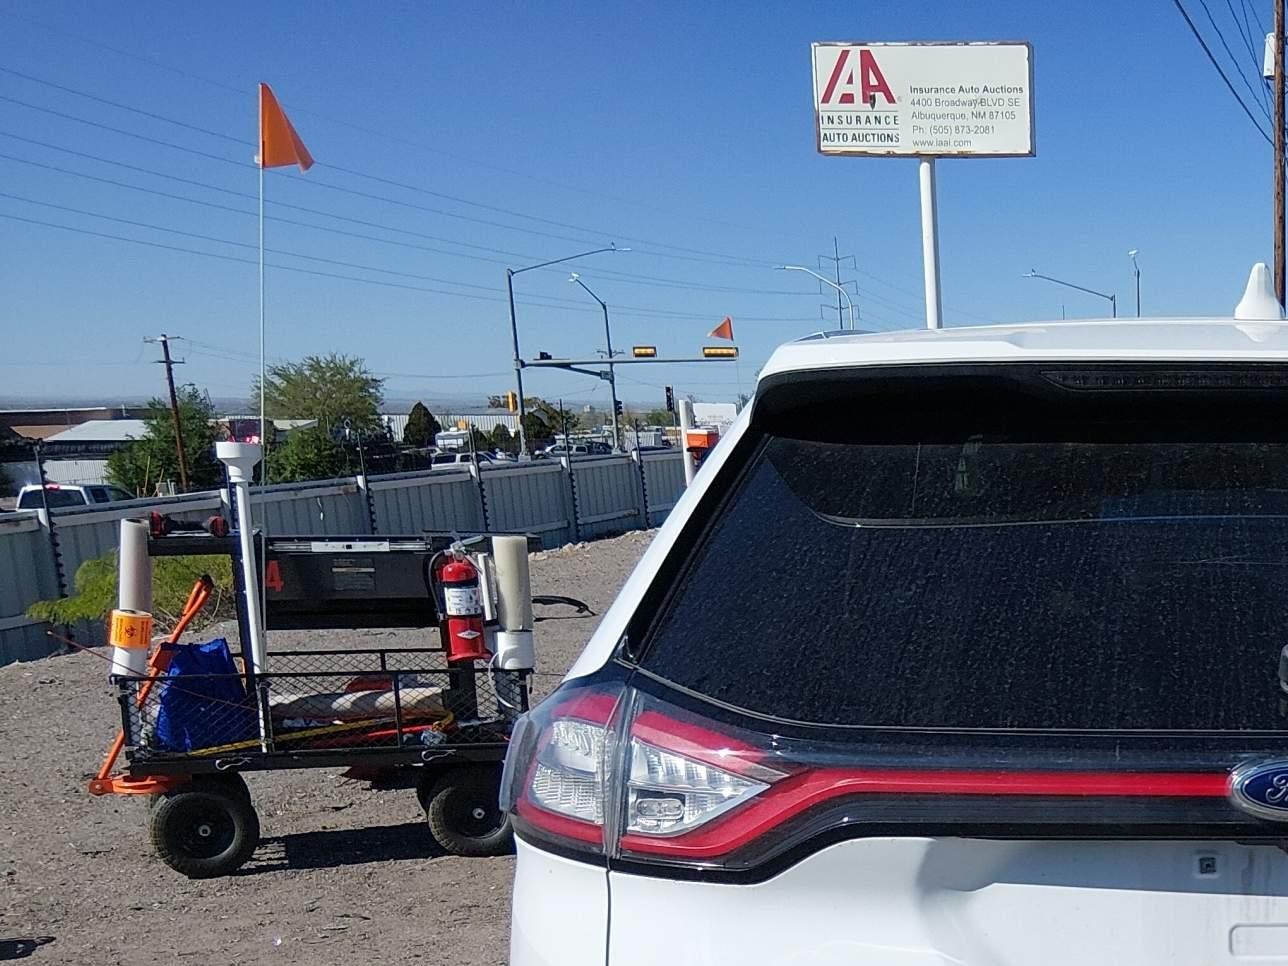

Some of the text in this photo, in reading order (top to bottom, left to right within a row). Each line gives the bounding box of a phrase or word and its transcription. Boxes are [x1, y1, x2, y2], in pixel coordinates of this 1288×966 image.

[910, 85, 1024, 94] Insurance Auto Auctions
[910, 98, 932, 107] 4400
[1007, 98, 1021, 107] SE
[821, 115, 900, 125] INSURANCE
[911, 111, 1016, 122] Albuquerque, NM 87105
[929, 125, 952, 136] (505)
[822, 133, 900, 143] AUTO AUCTIONS
